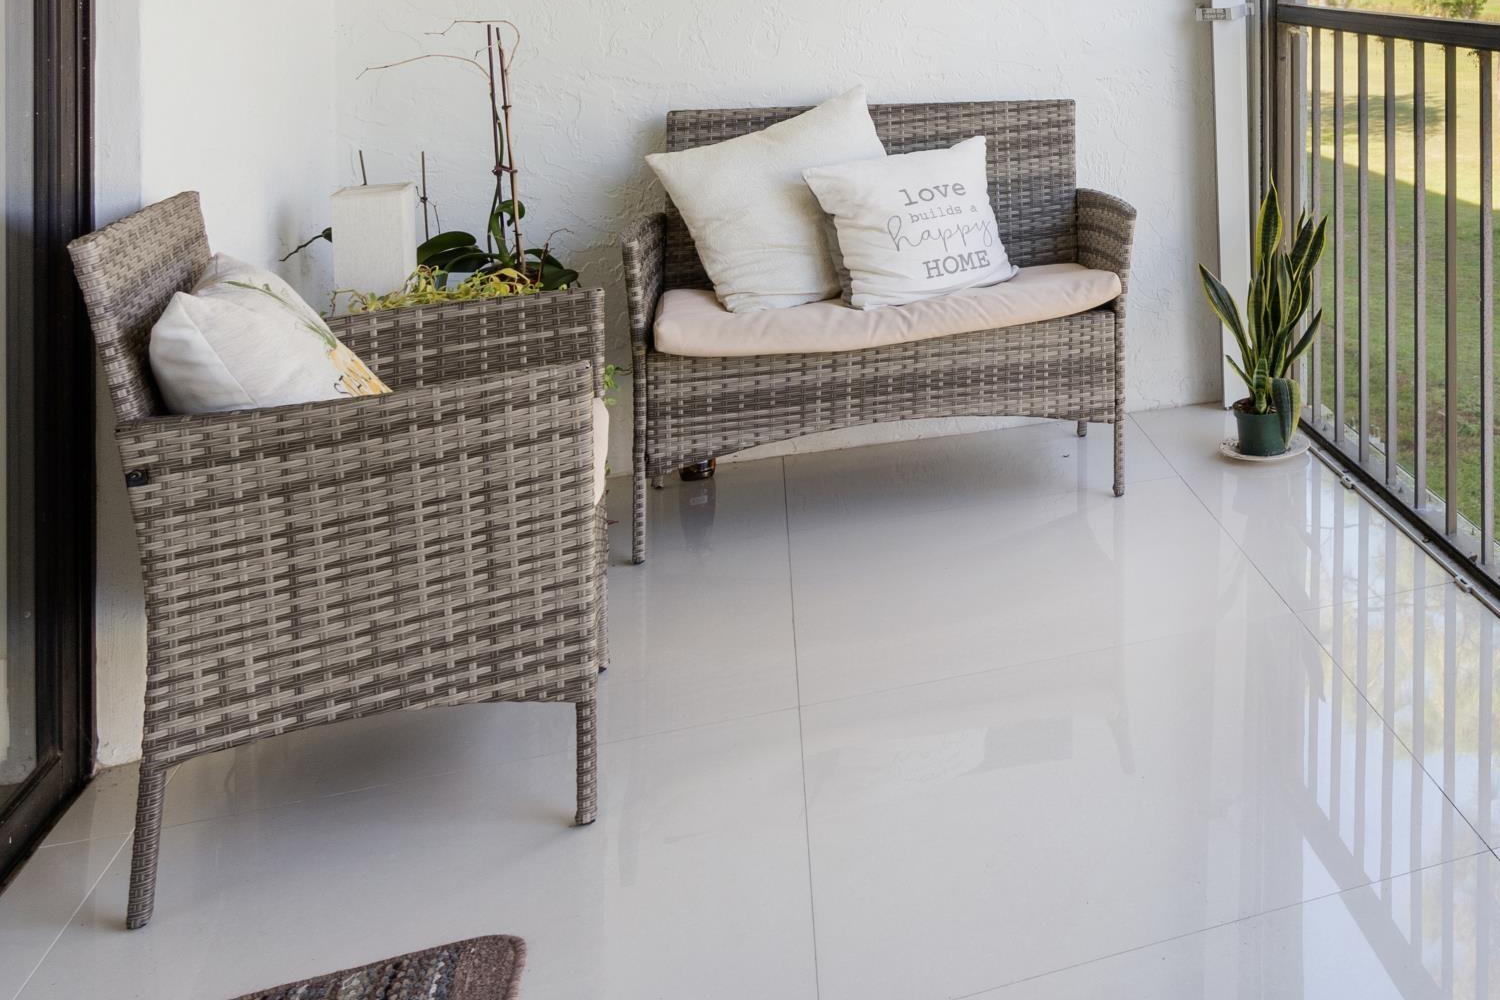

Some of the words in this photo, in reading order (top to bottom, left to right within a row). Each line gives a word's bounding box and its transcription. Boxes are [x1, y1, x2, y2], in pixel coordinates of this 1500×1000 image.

[899, 183, 966, 206] love
[909, 205, 962, 223] builds
[970, 205, 978, 213] a
[888, 215, 992, 252] happy
[922, 250, 991, 279] HOME
